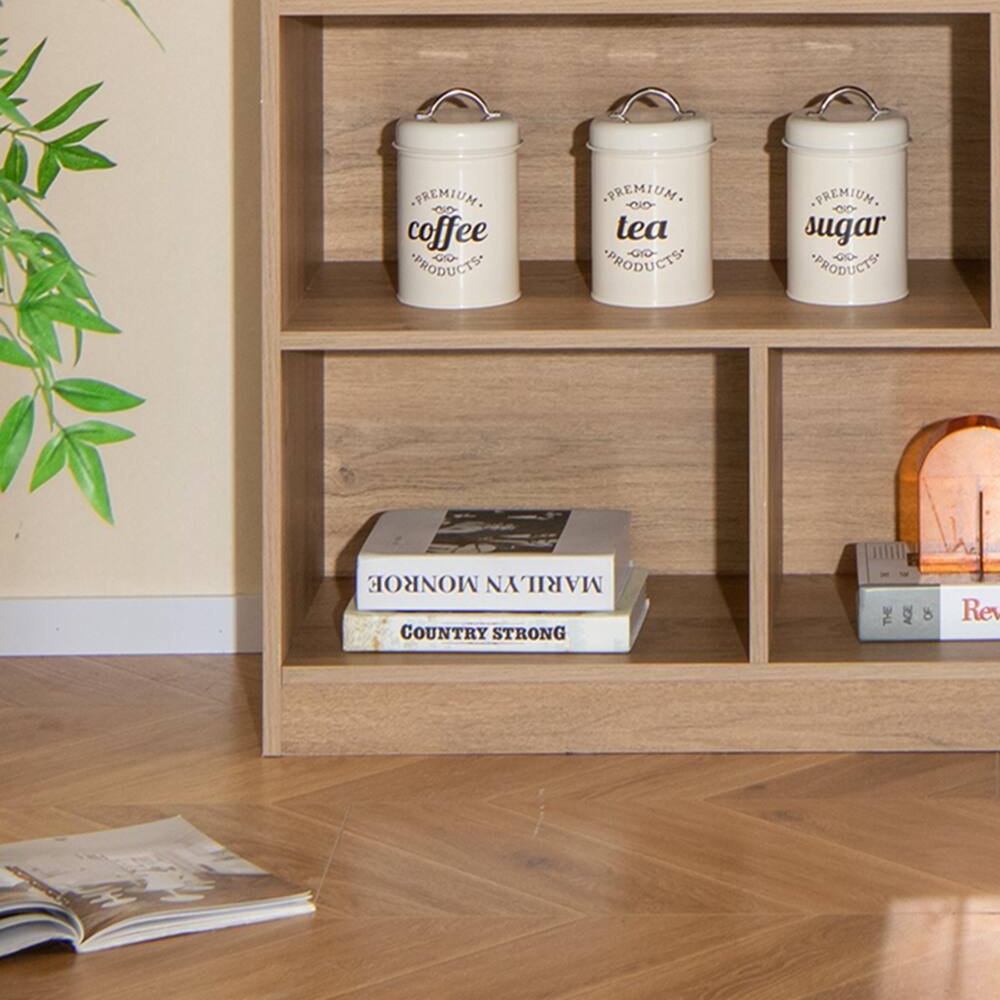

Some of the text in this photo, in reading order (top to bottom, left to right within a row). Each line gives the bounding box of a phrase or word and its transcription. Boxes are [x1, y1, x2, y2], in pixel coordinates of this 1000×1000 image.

[415, 188, 478, 206] PREMIUM
[607, 184, 678, 201] PREMIUM
[815, 188, 875, 205] PREMIUM
[408, 215, 488, 251] coffee
[616, 215, 668, 240] tea
[805, 215, 887, 246] sugar
[414, 255, 481, 277] PRODUCTS
[607, 250, 682, 273] PRODUCTS
[814, 254, 878, 276] PRODUCTS
[368, 575, 604, 594] MARILYN MONROE
[882, 606, 892, 626] THE
[903, 605, 913, 625] AGE
[923, 607, 934, 621] OF
[401, 624, 567, 641] COUNTRY STRONG
